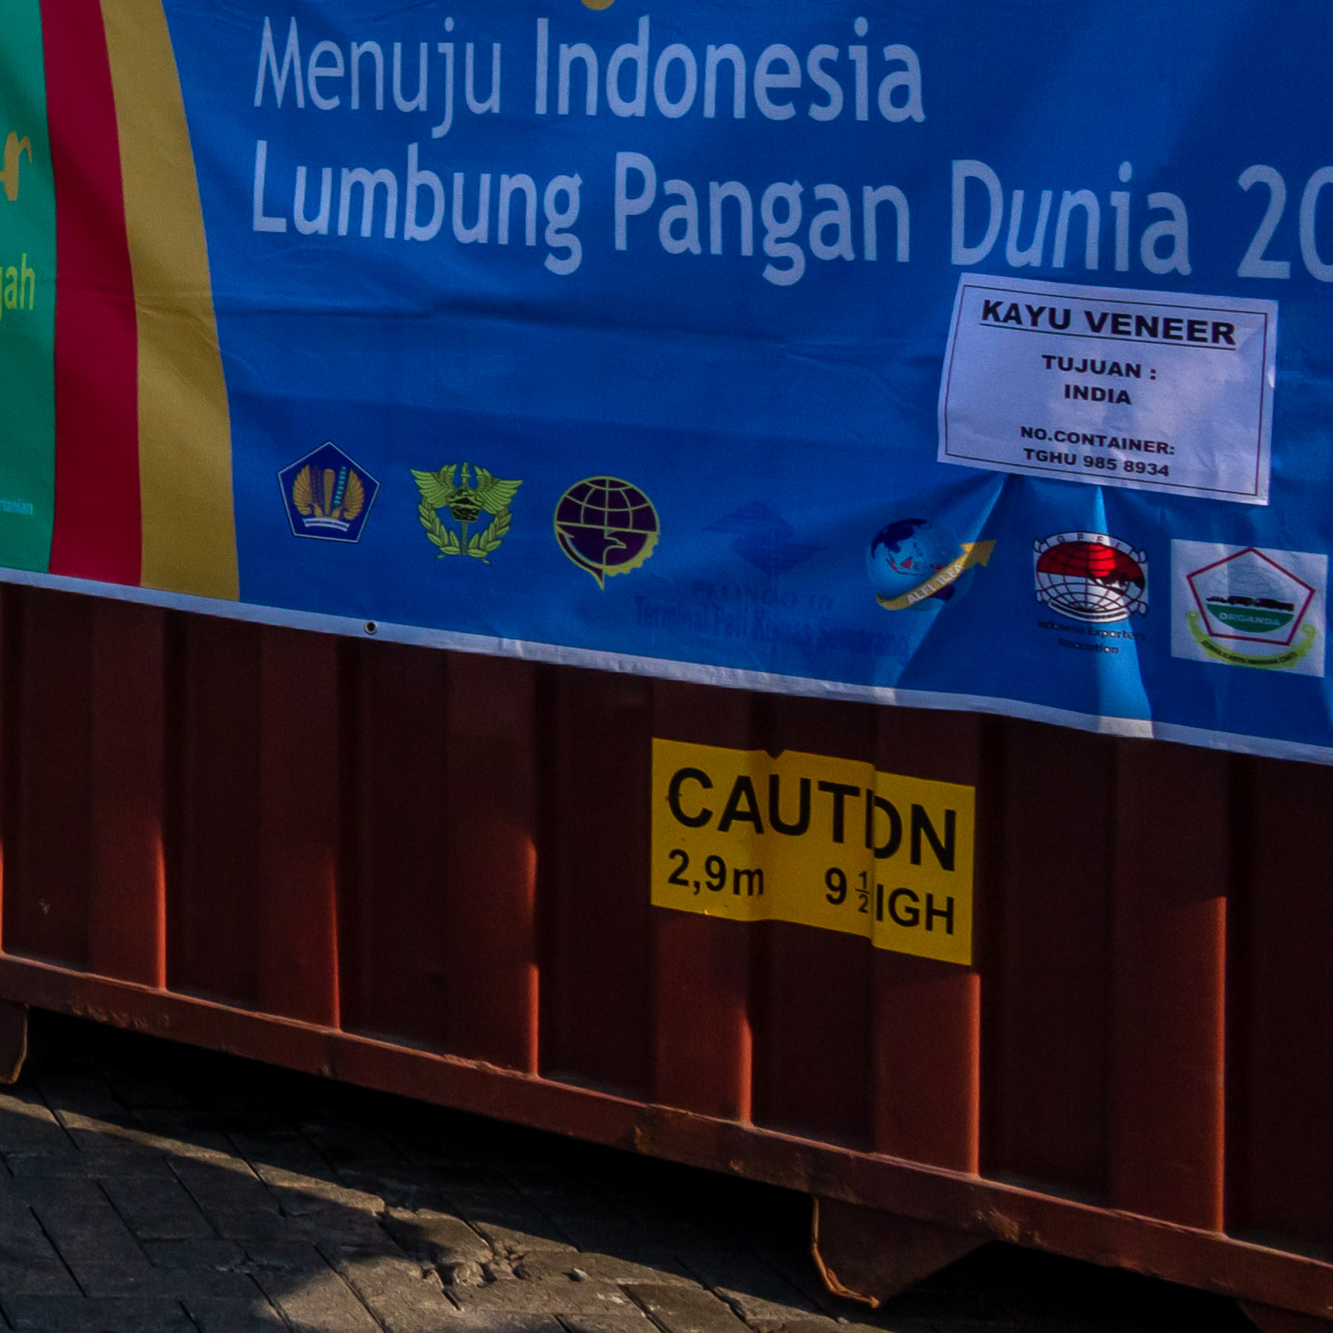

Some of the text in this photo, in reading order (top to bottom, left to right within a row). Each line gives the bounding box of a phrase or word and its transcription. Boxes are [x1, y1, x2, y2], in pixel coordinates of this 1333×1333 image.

[253, 15, 926, 139] Menuju Indonesia
[252, 139, 583, 275] Lumbung
[615, 151, 910, 286] Pangan
[951, 157, 1192, 276] Dunia
[981, 299, 1237, 345] KAYU VENEER
[1041, 354, 1142, 380] TUJUAN
[1064, 383, 1132, 406] INDIA
[1020, 425, 1176, 456] NO.CONTAINER:
[1023, 448, 1170, 478] TGHU 985 8934
[1218, 612, 1281, 627] ORGANDA
